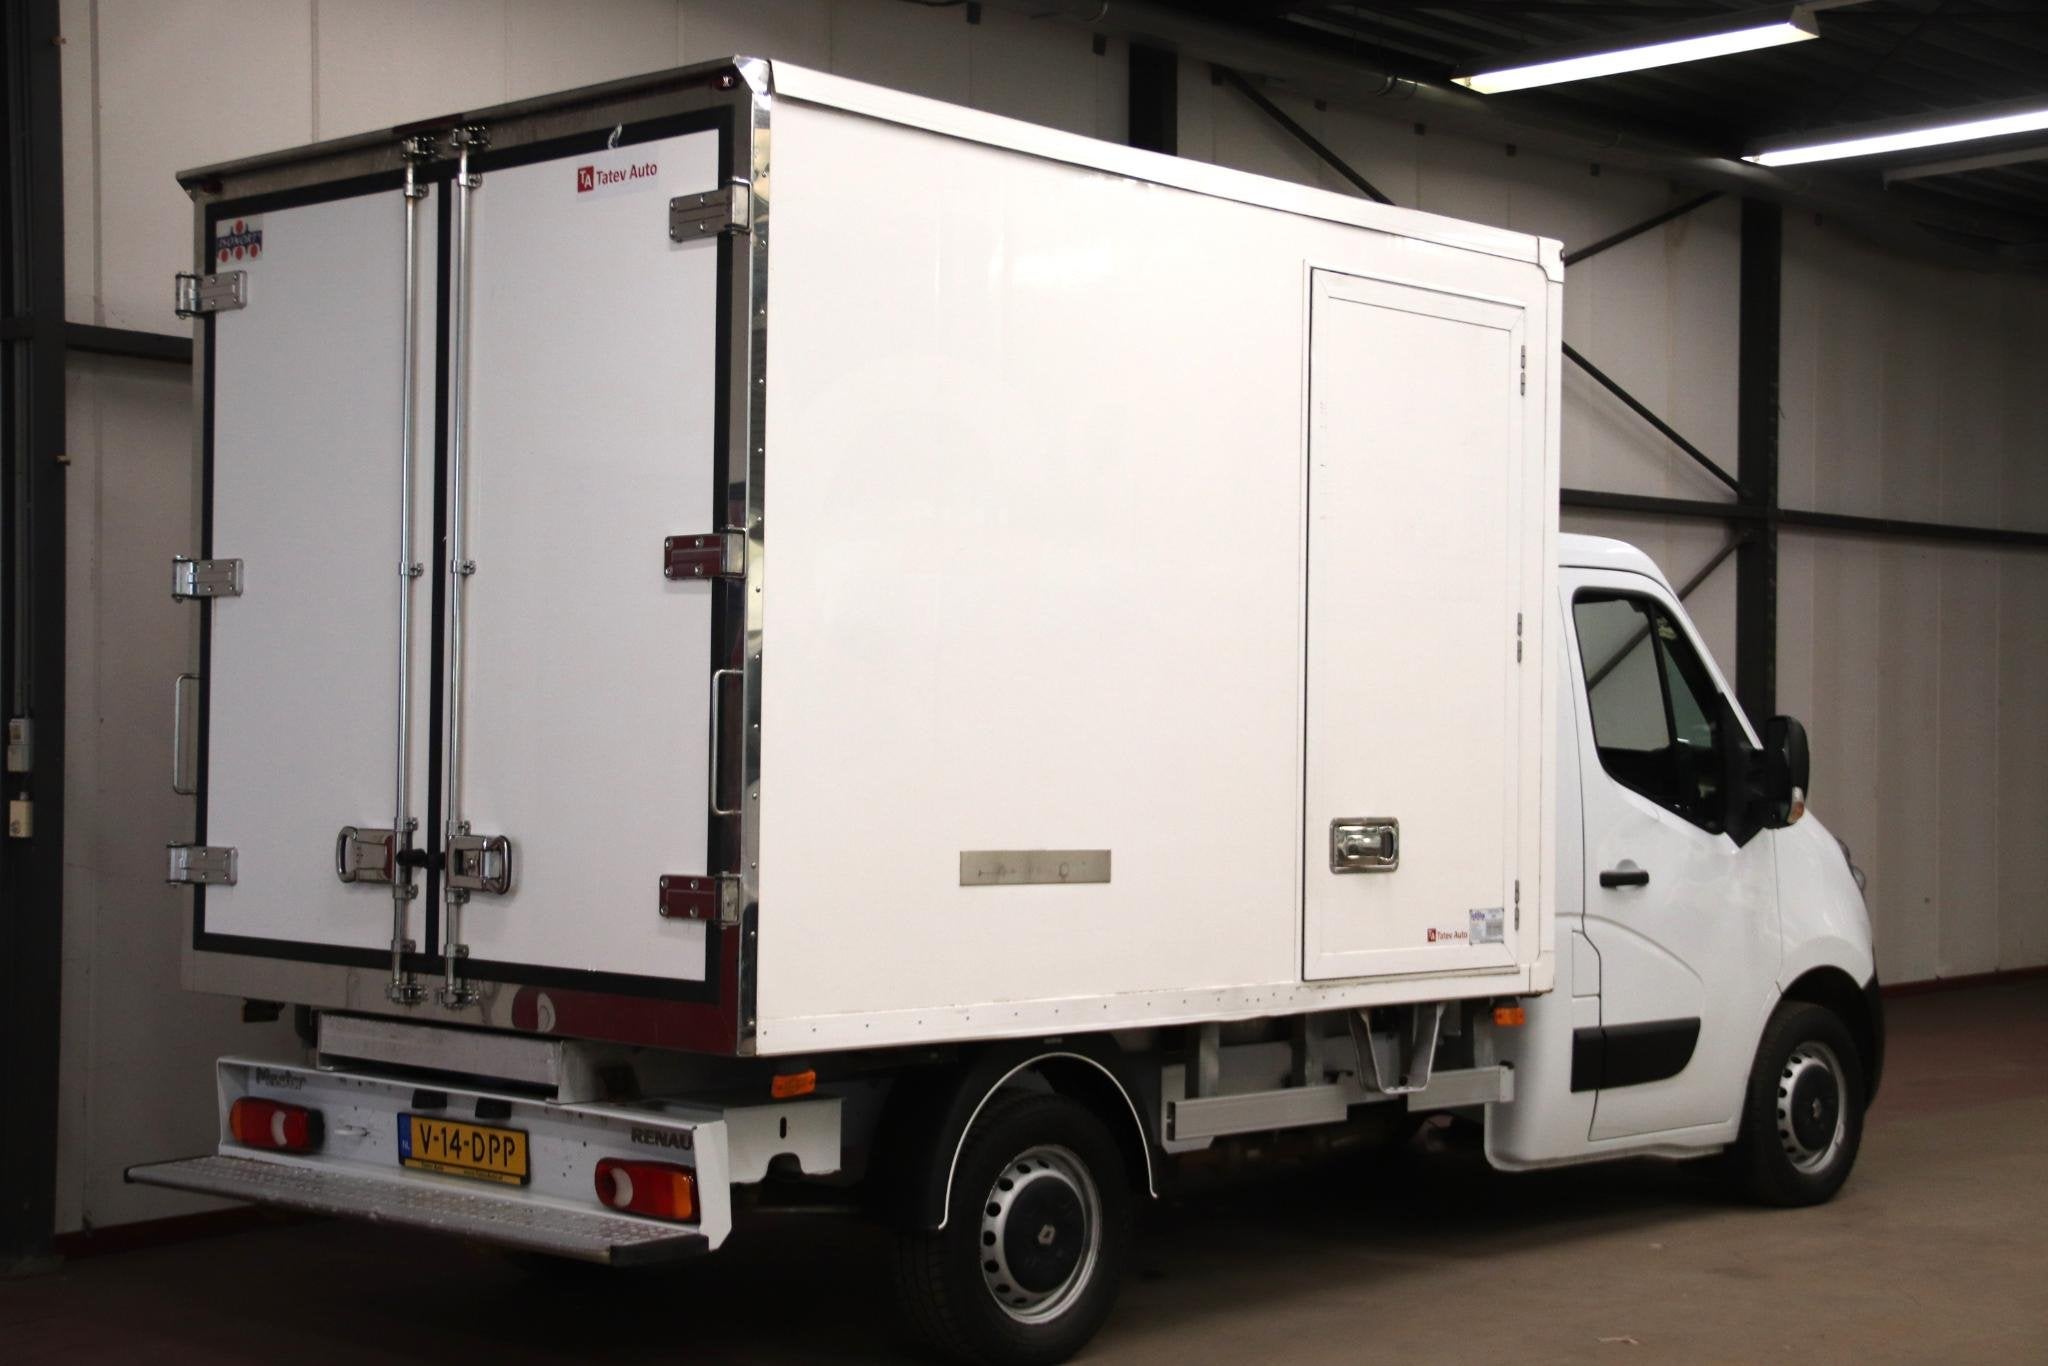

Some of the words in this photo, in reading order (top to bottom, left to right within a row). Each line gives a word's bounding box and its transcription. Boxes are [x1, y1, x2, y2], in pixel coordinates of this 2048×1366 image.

[596, 169, 627, 185] Tatev
[629, 162, 658, 180] Auto
[1437, 932, 1453, 940] Tatev
[1453, 930, 1468, 939] Auto
[420, 1123, 516, 1167] V-14-DPP
